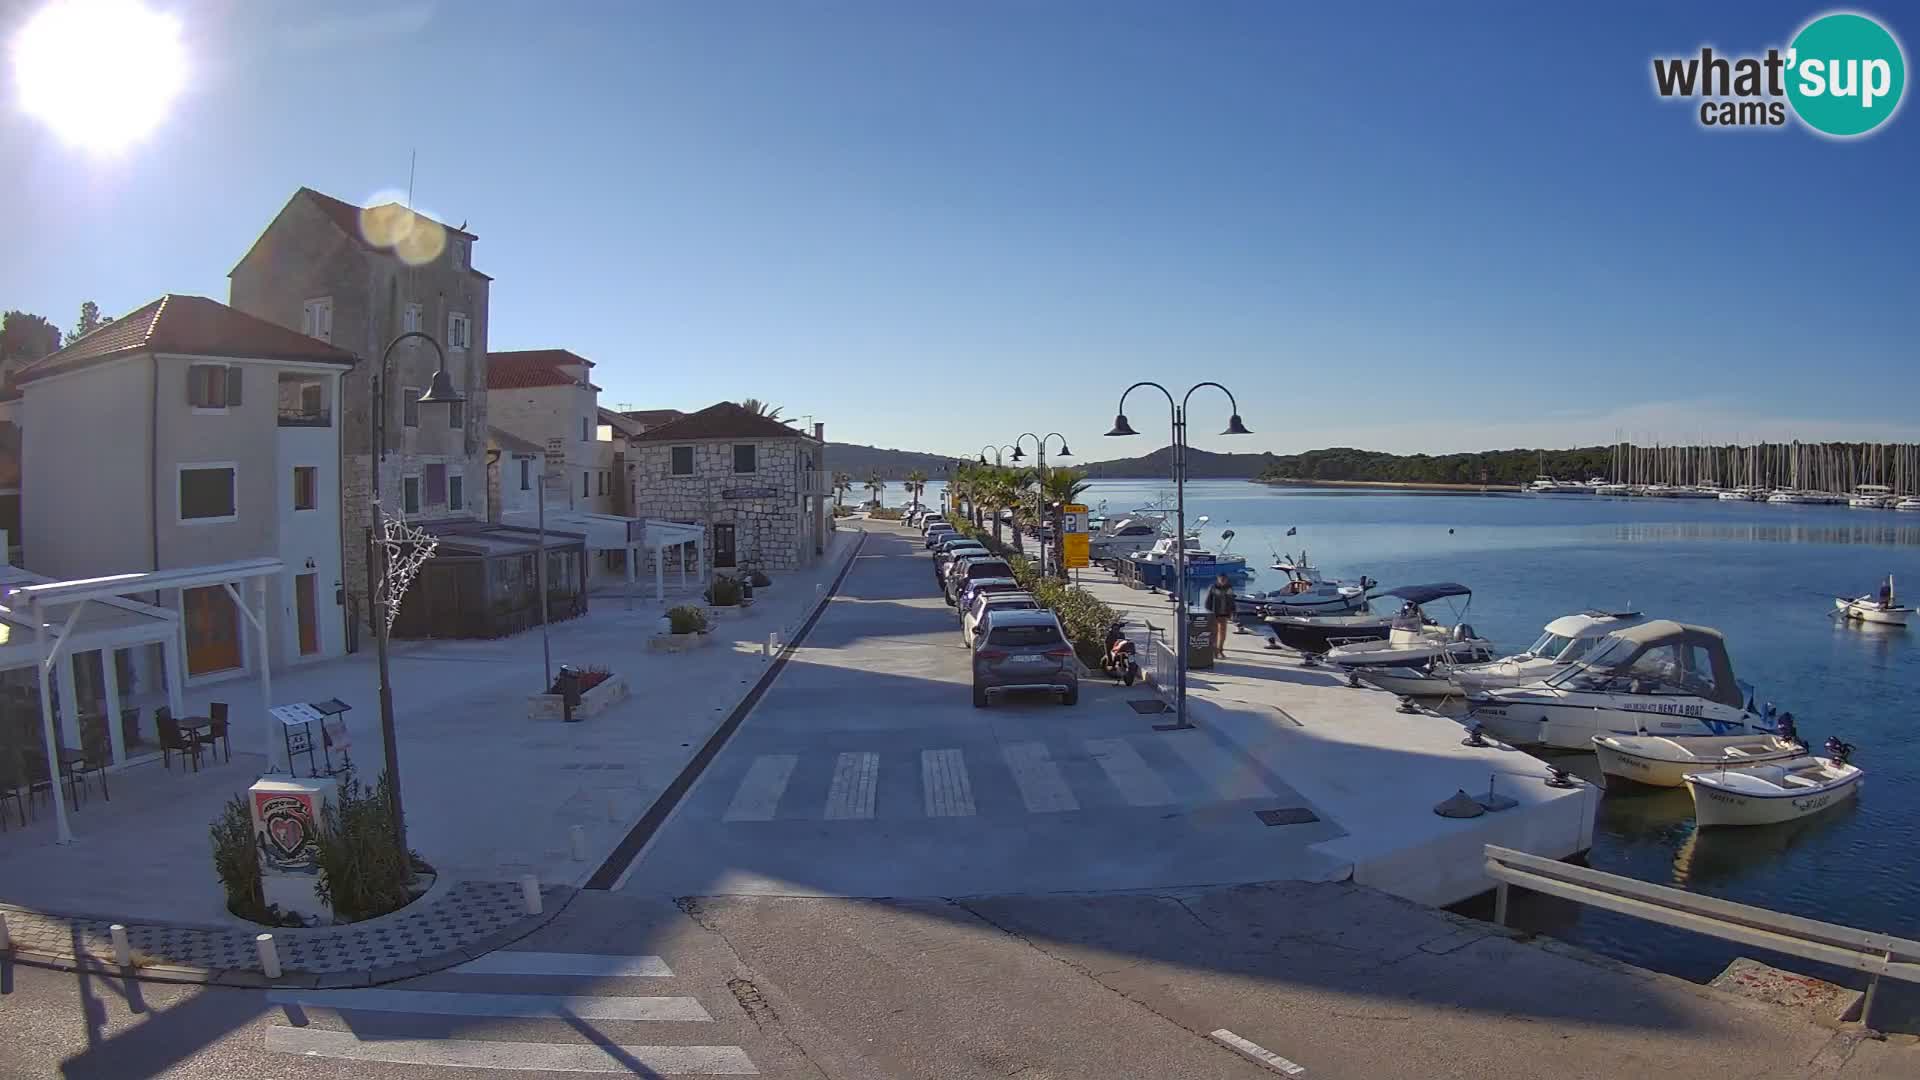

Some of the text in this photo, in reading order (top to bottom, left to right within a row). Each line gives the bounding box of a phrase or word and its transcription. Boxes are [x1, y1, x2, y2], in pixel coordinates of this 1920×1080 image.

[1065, 515, 1076, 531] P
[1658, 703, 1677, 714] RENT
[1678, 704, 1684, 714] A
[1685, 705, 1704, 716] BOAT
